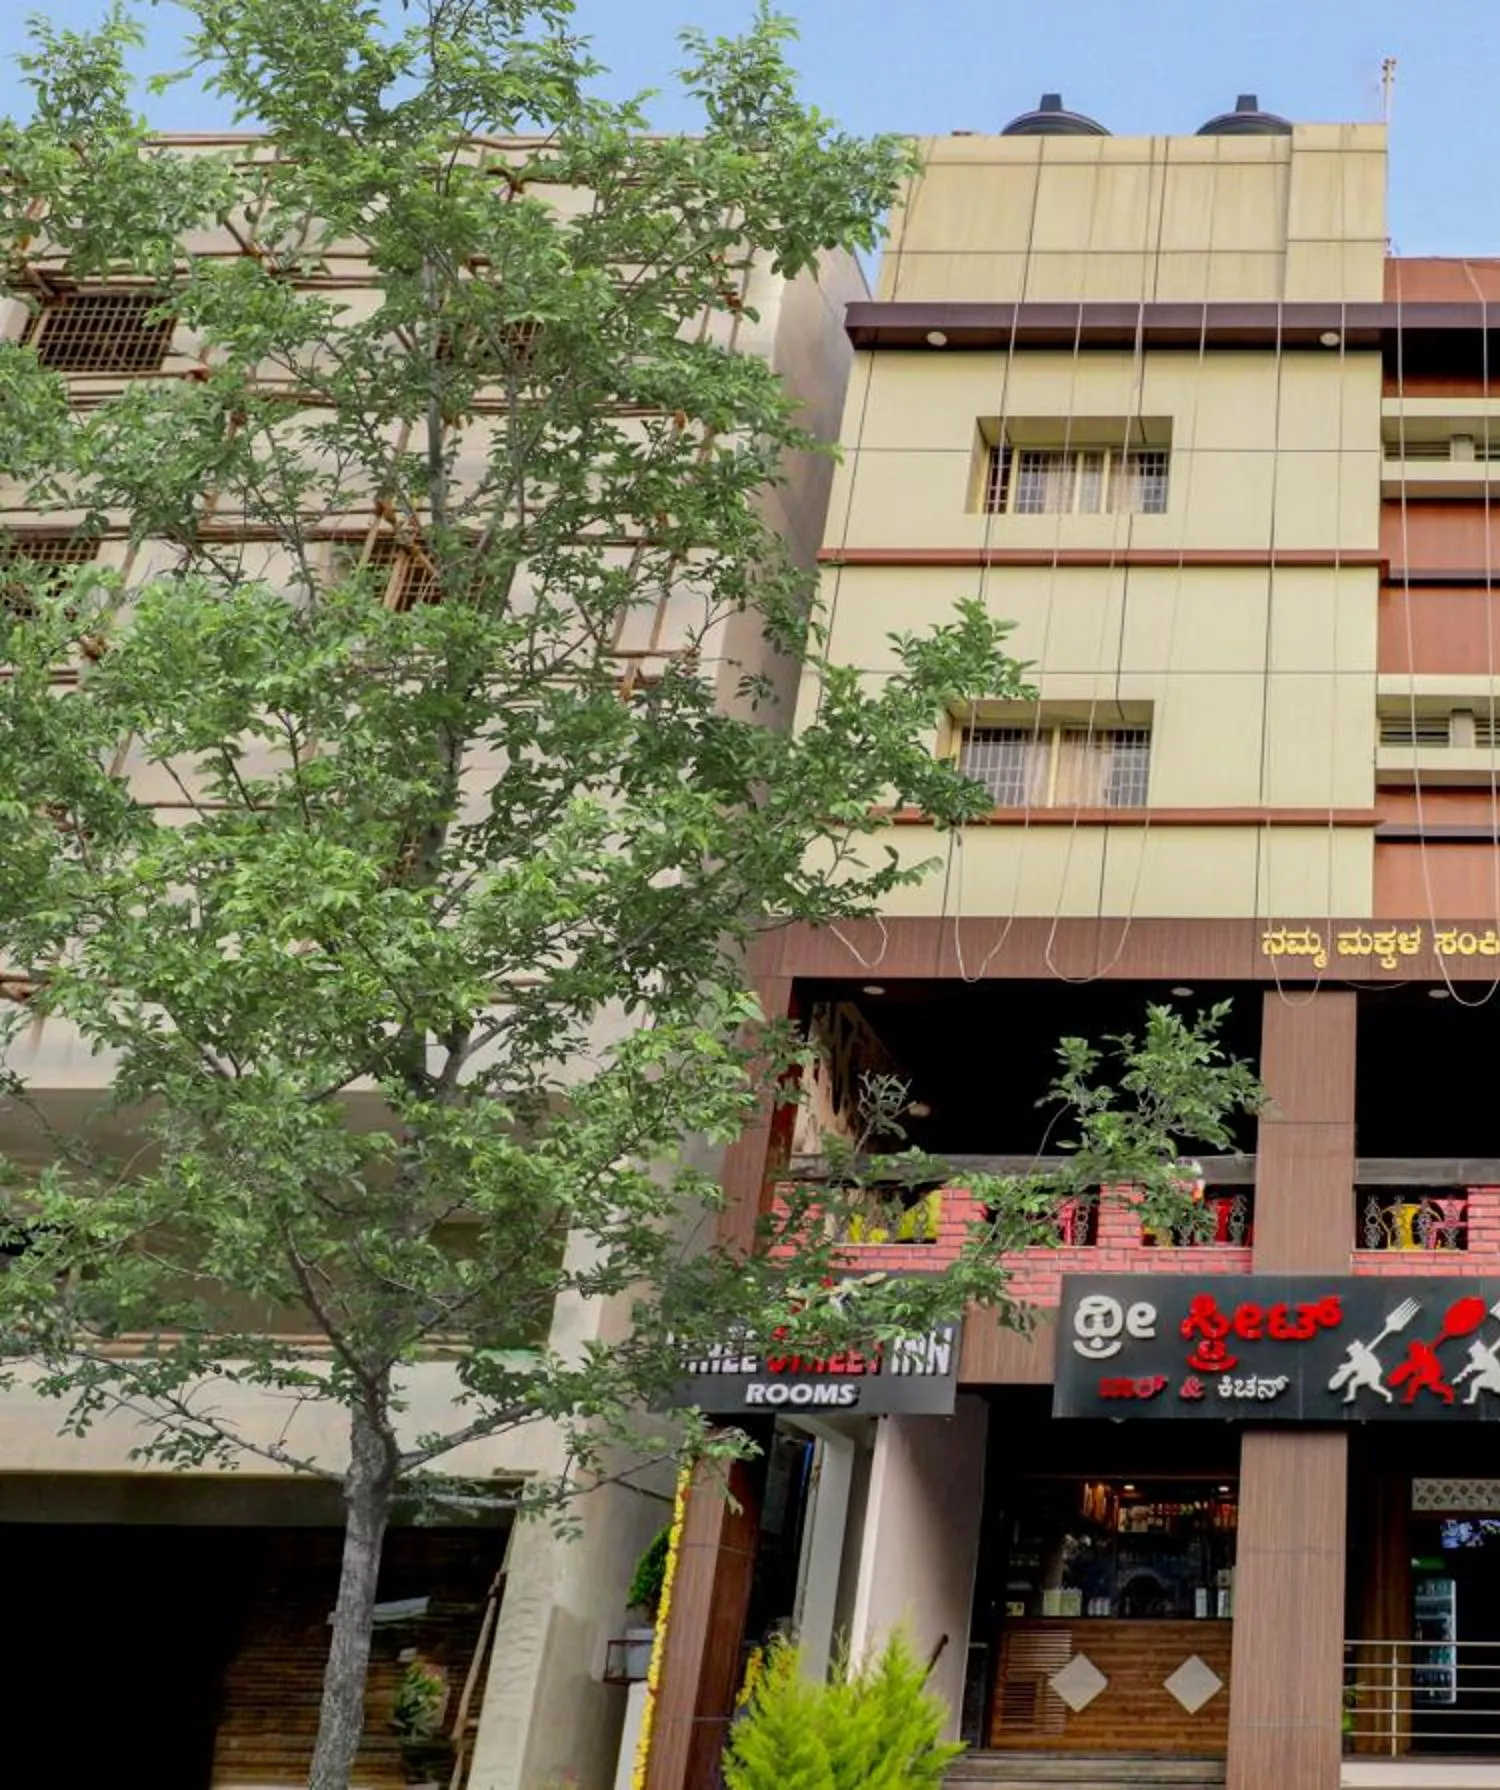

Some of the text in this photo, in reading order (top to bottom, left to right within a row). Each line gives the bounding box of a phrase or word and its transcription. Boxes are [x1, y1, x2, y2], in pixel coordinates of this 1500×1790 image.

[1262, 924, 1328, 969] ನಮ್ಮ
[1337, 924, 1421, 970] ಮಕ್ಕಳ
[889, 1327, 954, 1375] INN
[745, 1383, 857, 1406] ROOMS
[1179, 1375, 1206, 1398] &
[1217, 1373, 1290, 1400] ಕಿಚನ್
